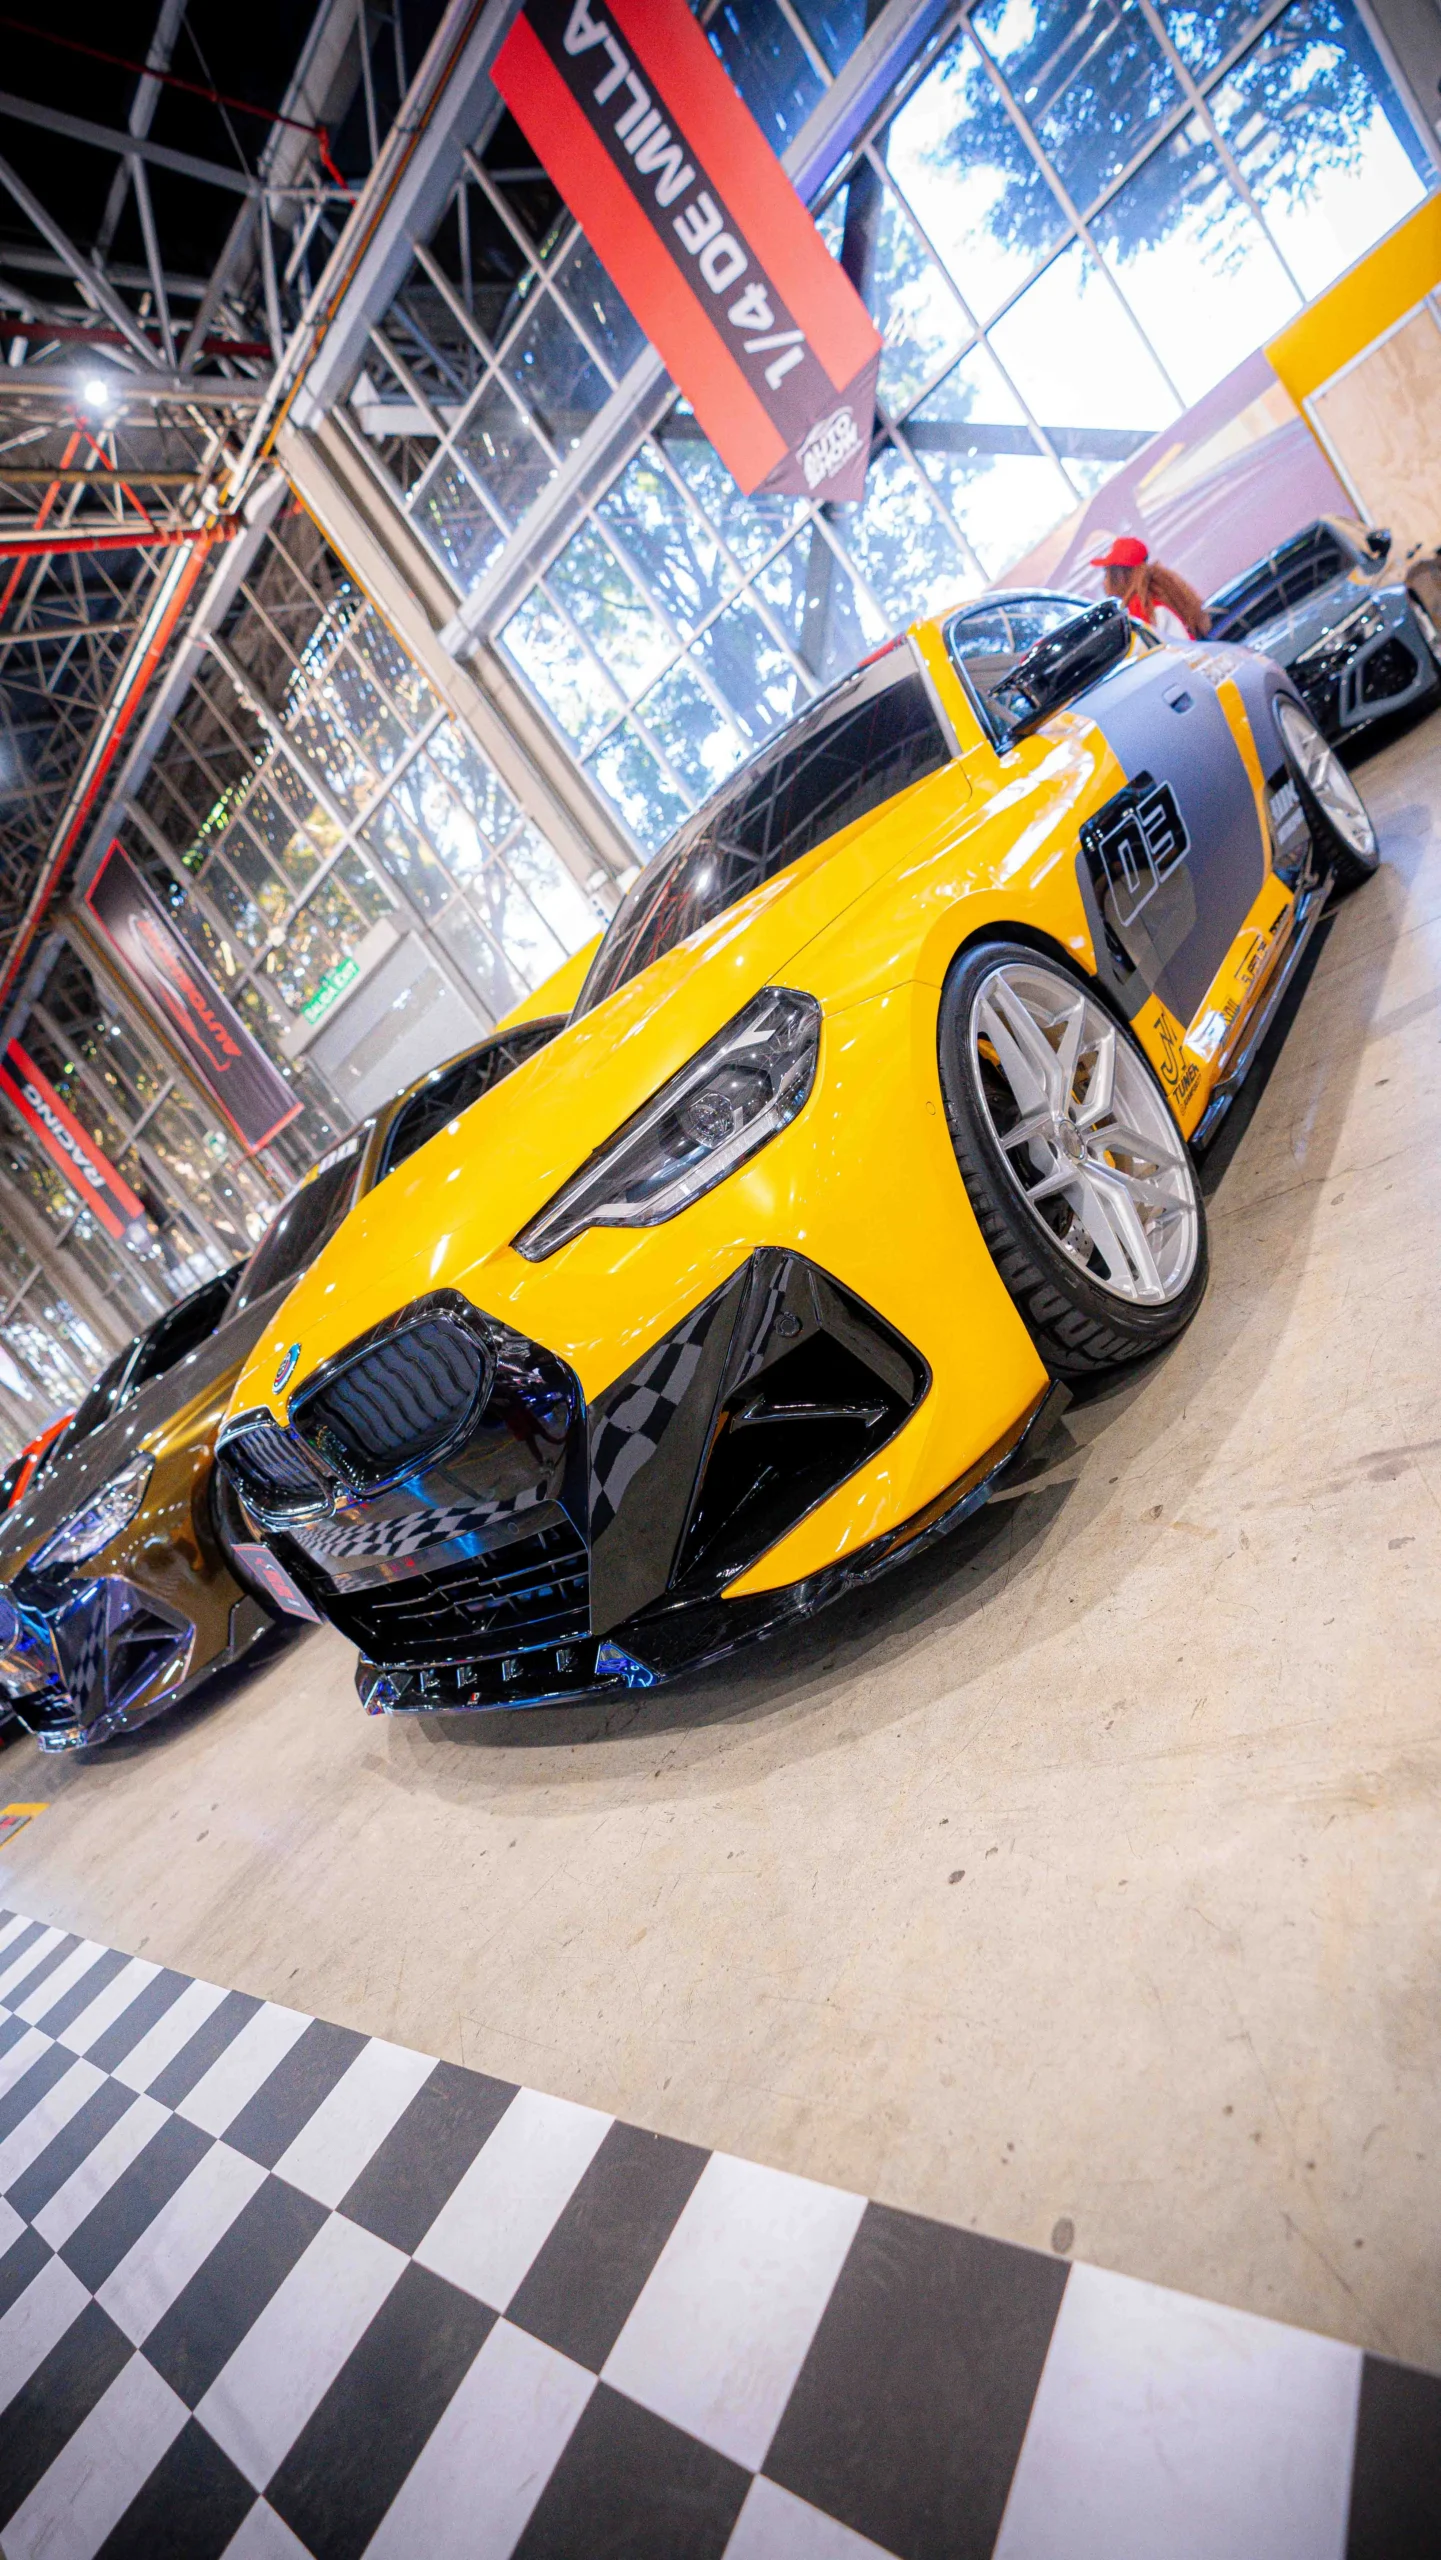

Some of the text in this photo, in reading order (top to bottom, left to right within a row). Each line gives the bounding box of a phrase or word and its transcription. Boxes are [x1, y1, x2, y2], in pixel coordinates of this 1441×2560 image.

[563, 0, 805, 391] 1/4 DE MILLA
[803, 413, 853, 472] AUTO
[1099, 780, 1191, 924] 03
[21, 1083, 106, 1188] RACING
